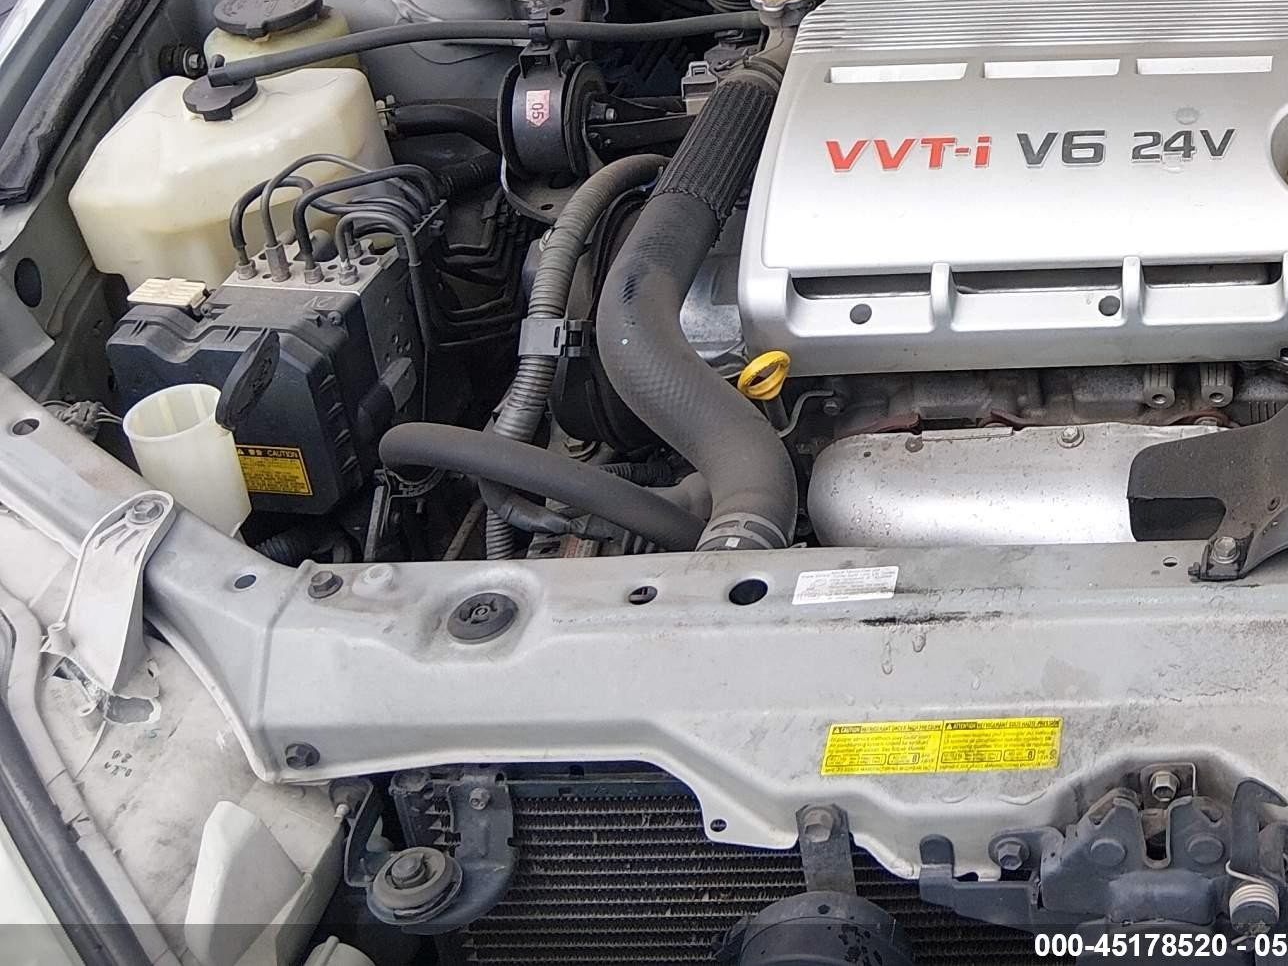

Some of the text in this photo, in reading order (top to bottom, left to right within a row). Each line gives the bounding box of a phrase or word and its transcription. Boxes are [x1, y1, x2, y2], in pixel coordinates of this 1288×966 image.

[531, 102, 545, 120] 05
[825, 129, 1236, 172] VVT-i V6 24V
[266, 449, 299, 459] CAUTION
